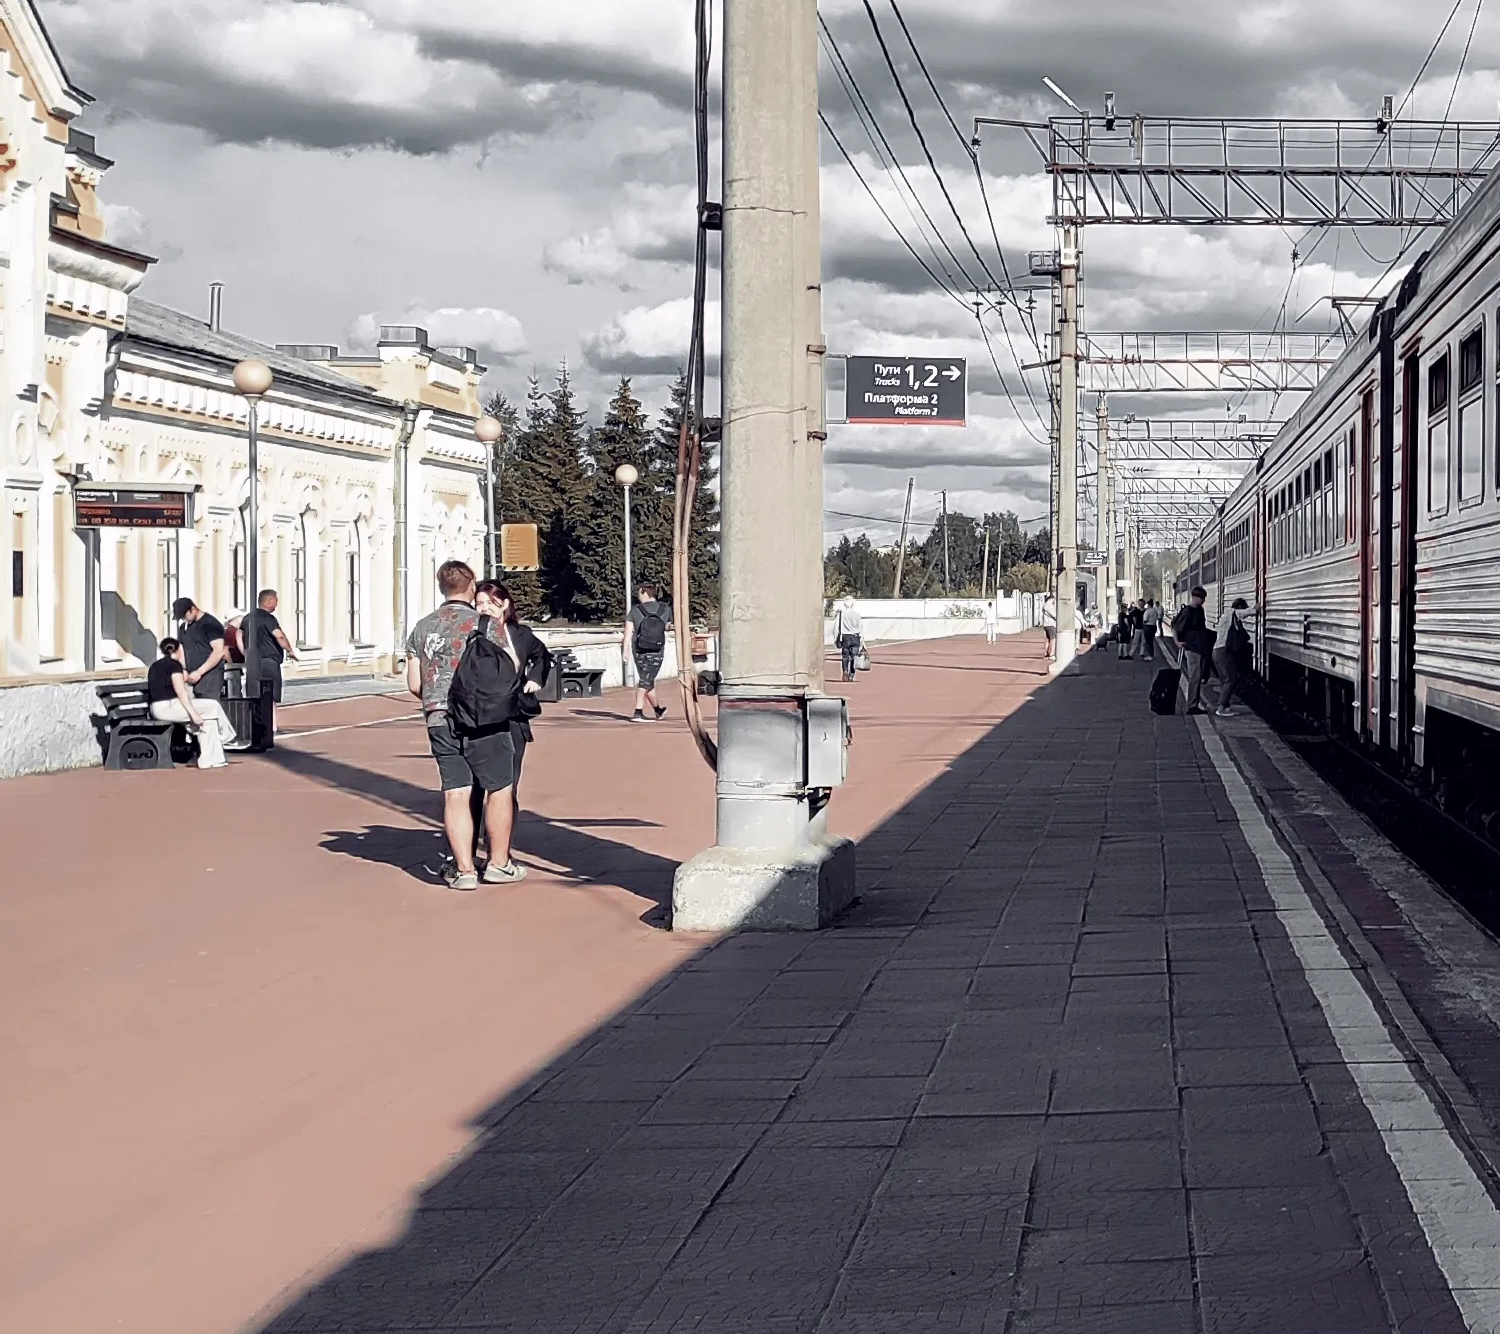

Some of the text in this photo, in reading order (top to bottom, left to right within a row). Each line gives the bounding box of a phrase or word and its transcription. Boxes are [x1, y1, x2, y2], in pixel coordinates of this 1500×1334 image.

[875, 364, 901, 376] Пути
[875, 378, 901, 386] Tracks
[865, 393, 938, 406] Платформа 2
[895, 407, 938, 415] Platform 2
